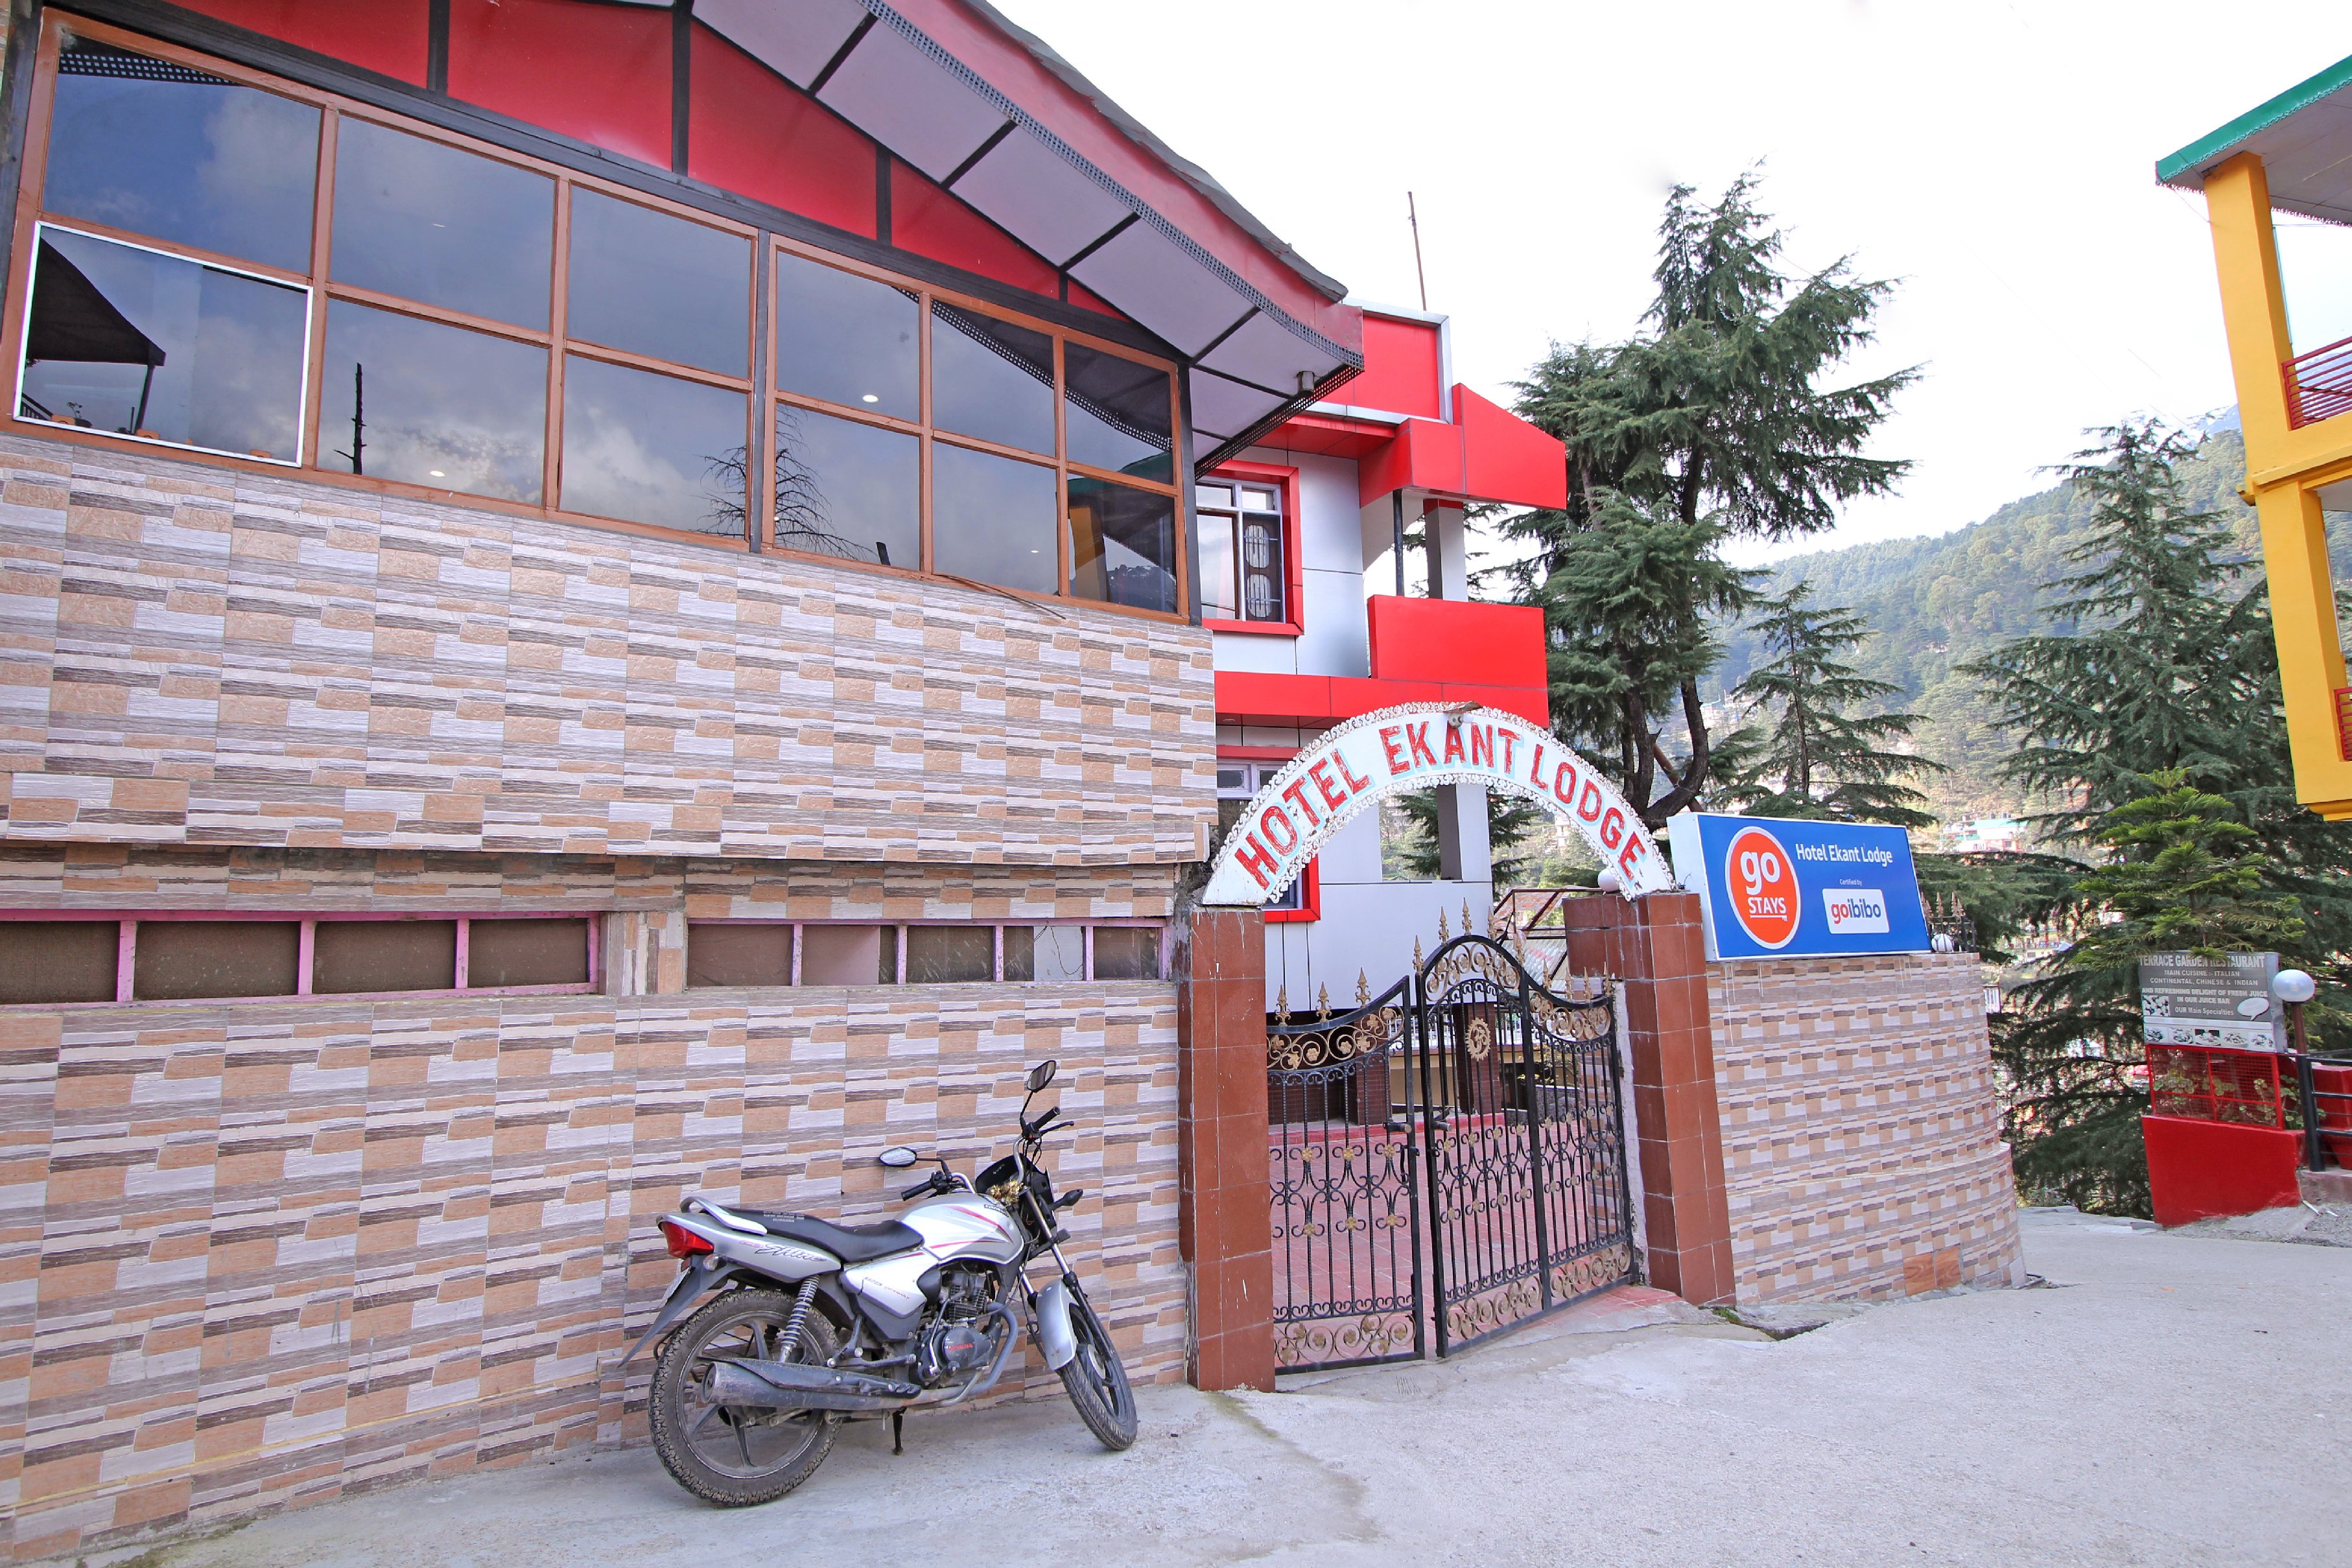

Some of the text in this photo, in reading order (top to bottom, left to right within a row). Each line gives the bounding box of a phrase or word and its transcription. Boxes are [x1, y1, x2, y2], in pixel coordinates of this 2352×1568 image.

[1234, 720, 1647, 891] HOTEL EKANT LODGE
[1795, 843, 1893, 867] Hotel Ekant Lodge
[1740, 851, 1780, 895] go
[1748, 896, 1786, 914] STAYS
[1831, 898, 1881, 924] goibibo
[2140, 955, 2174, 966] TERRACE
[2175, 955, 2208, 967] GARDEN
[2202, 1007, 2234, 1016] Specialties
